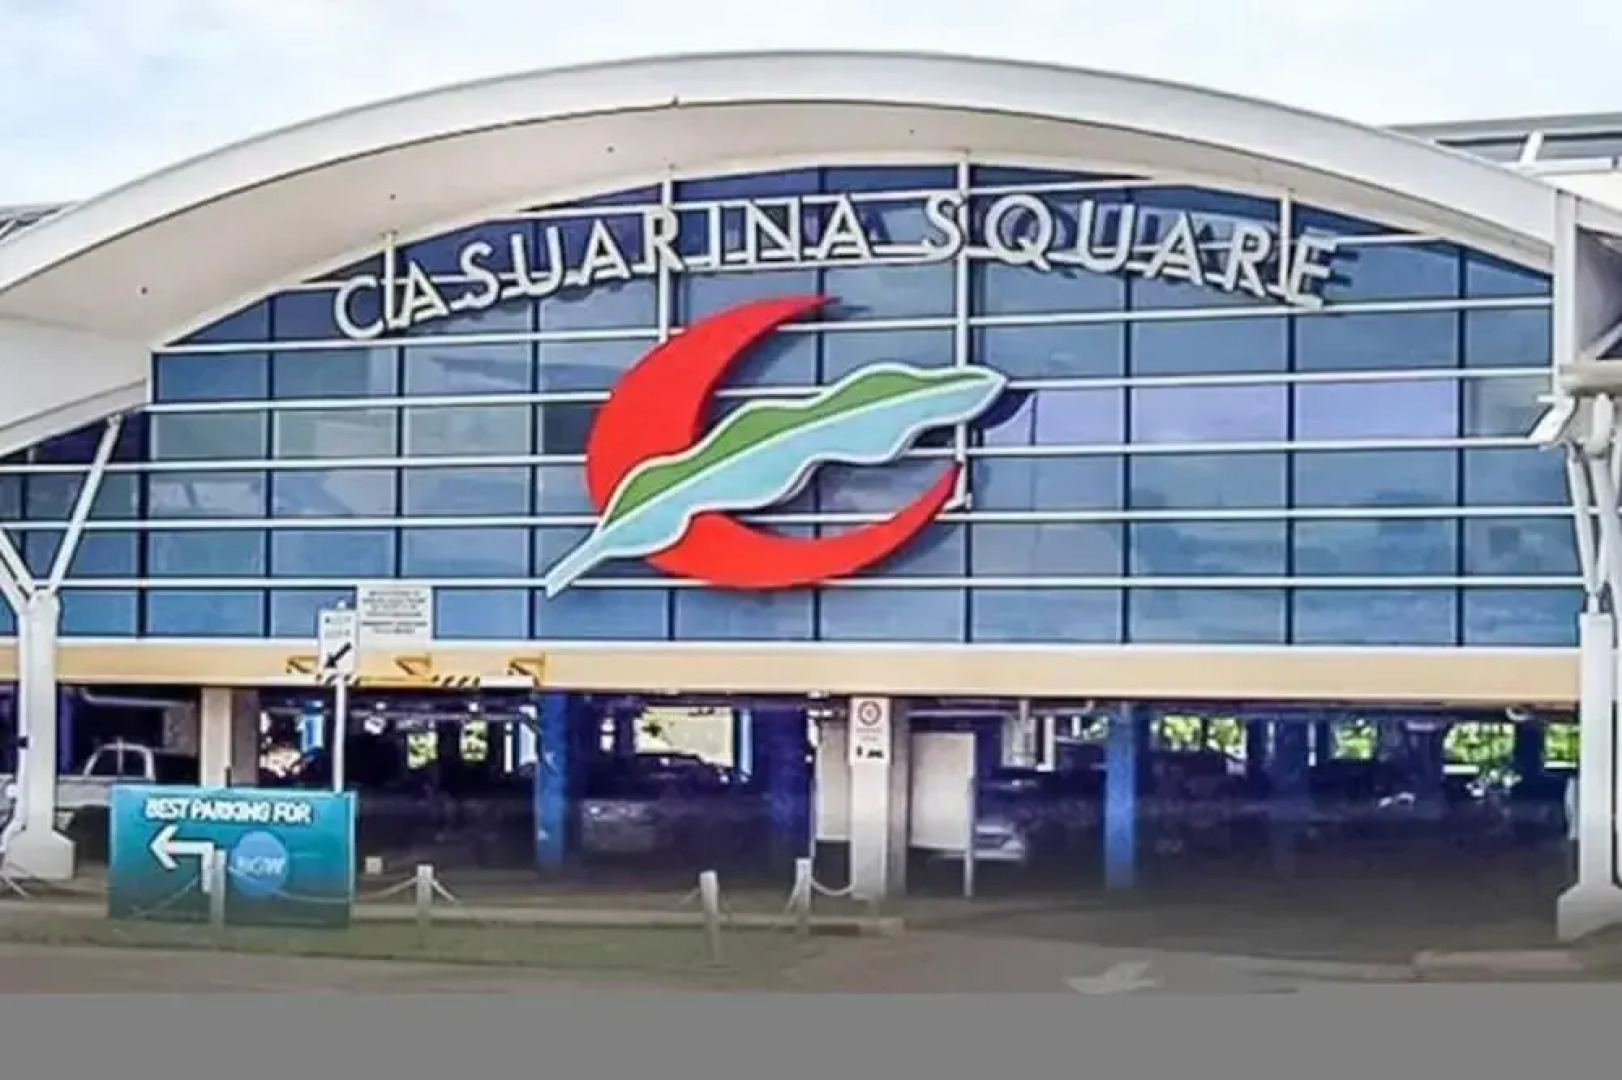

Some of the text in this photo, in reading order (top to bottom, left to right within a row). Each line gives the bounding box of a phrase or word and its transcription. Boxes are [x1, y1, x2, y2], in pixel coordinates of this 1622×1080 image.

[333, 191, 1340, 340] CASUARINA SQUARE
[145, 798, 312, 824] BEST PARKING FOR
